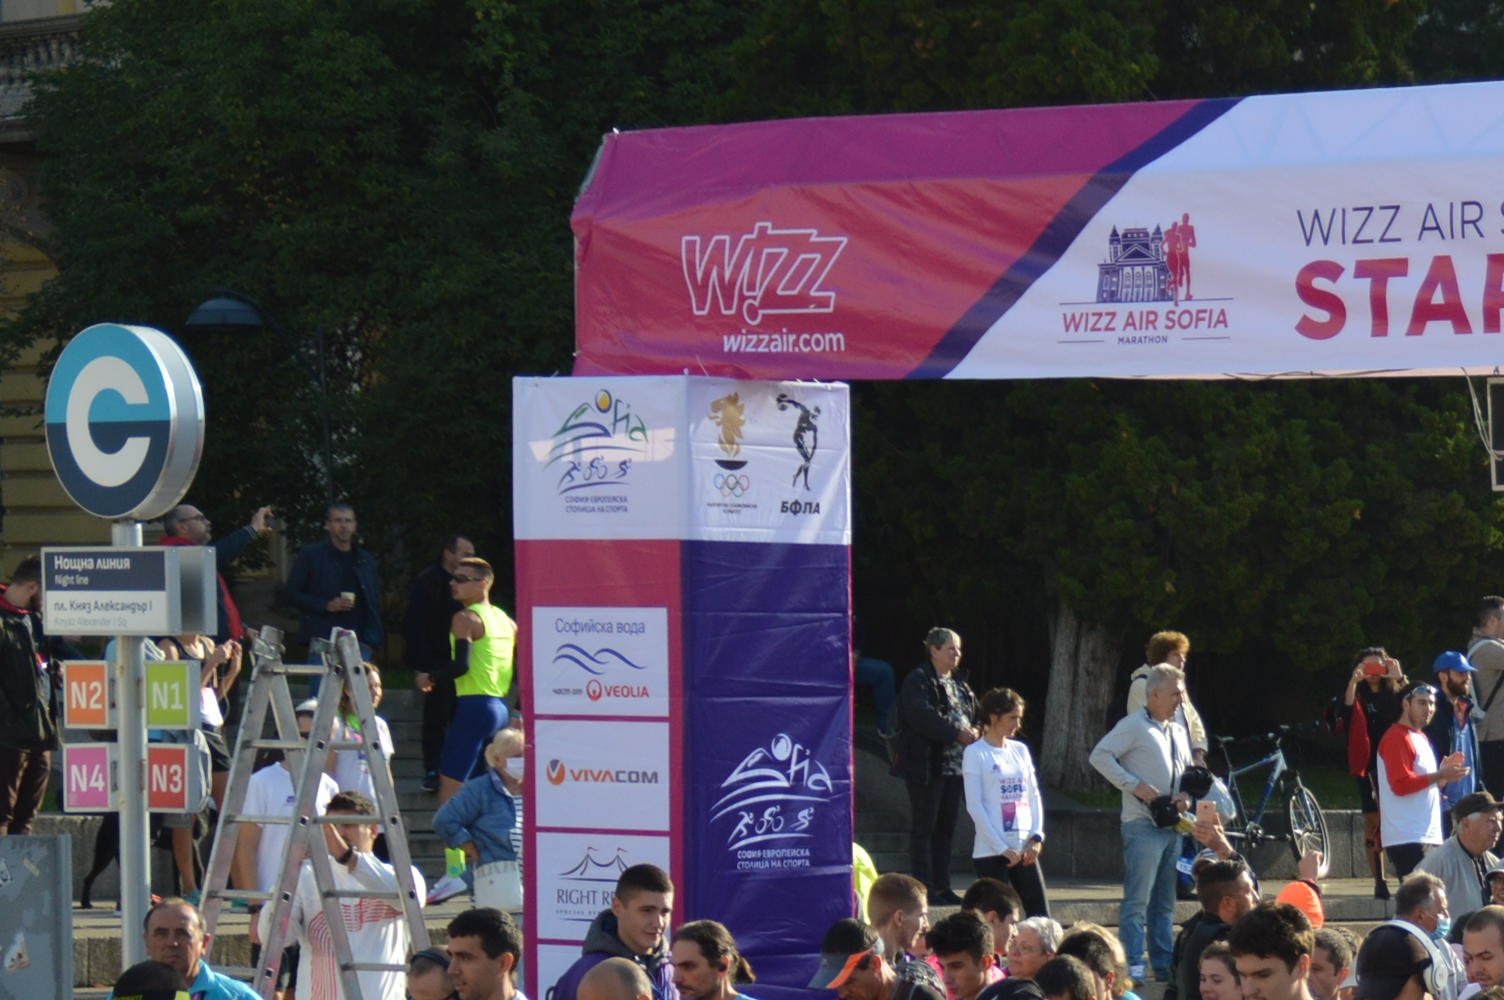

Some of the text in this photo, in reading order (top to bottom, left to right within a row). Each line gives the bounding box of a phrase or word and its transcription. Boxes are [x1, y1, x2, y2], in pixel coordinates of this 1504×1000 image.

[1297, 204, 1402, 247] WIZZ
[1417, 200, 1485, 242] AIR
[1063, 308, 1229, 333] WIZZ AIR SOFIA
[723, 328, 846, 352] wizzair.com
[1117, 335, 1168, 345] MARATHON
[780, 500, 820, 515] БФЛА
[54, 555, 130, 571] Нощна линия
[54, 574, 89, 586] Night line
[69, 601, 91, 614] Княз
[94, 601, 147, 614] Александър
[555, 617, 645, 636] Софийска вода
[71, 681, 103, 709] N2
[152, 681, 183, 710] N1
[604, 685, 649, 698] VEOLIA
[71, 764, 105, 792] N4
[152, 764, 183, 793] N3
[570, 768, 659, 784] VIVACOM
[737, 861, 770, 870] СТОЛИЦА
[783, 859, 810, 868] СПОРТА
[557, 889, 597, 905] RIGHT
